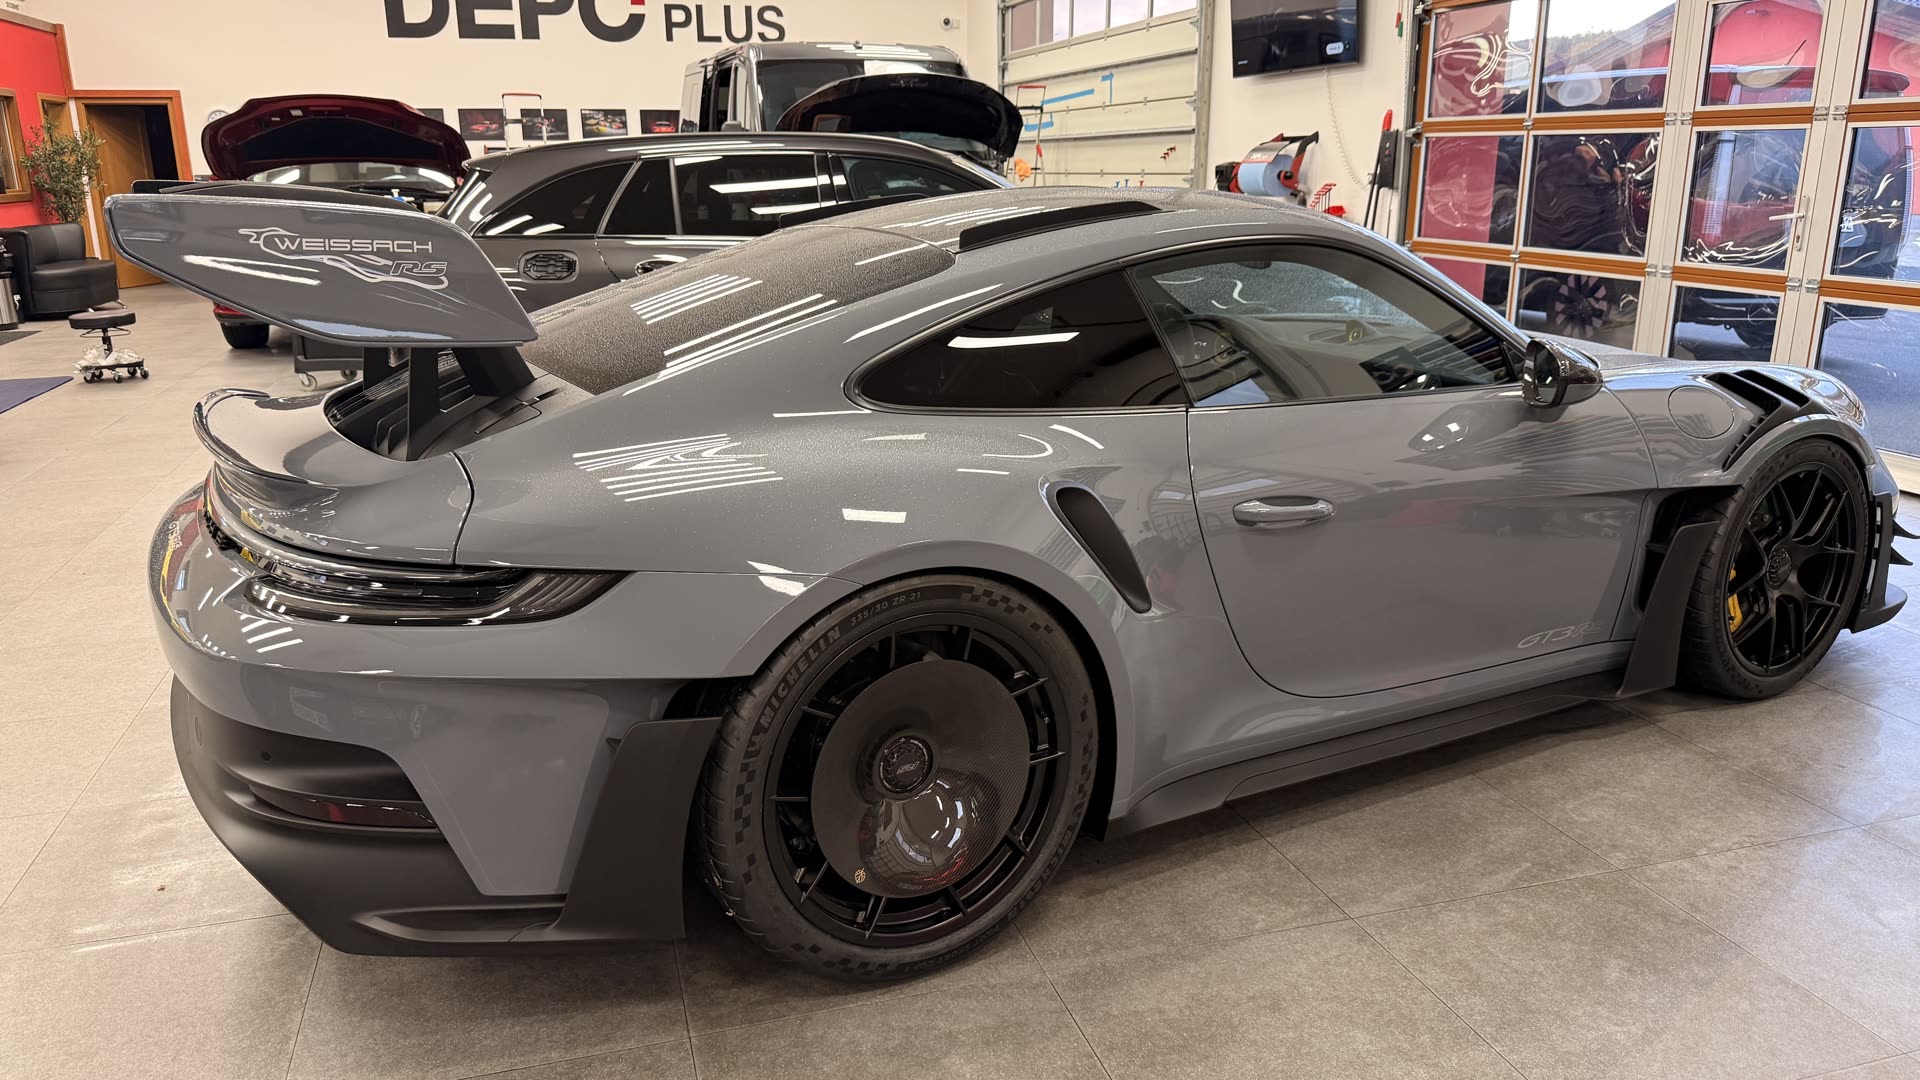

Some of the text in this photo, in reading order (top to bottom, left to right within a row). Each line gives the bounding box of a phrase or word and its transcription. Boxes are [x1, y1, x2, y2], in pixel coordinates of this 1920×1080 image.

[664, 4, 786, 43] PLUS
[274, 237, 433, 253] WEISSACH
[390, 261, 448, 277] RS
[759, 625, 841, 729] MICHELIN
[850, 601, 888, 626] 335/30
[910, 591, 921, 601] 21
